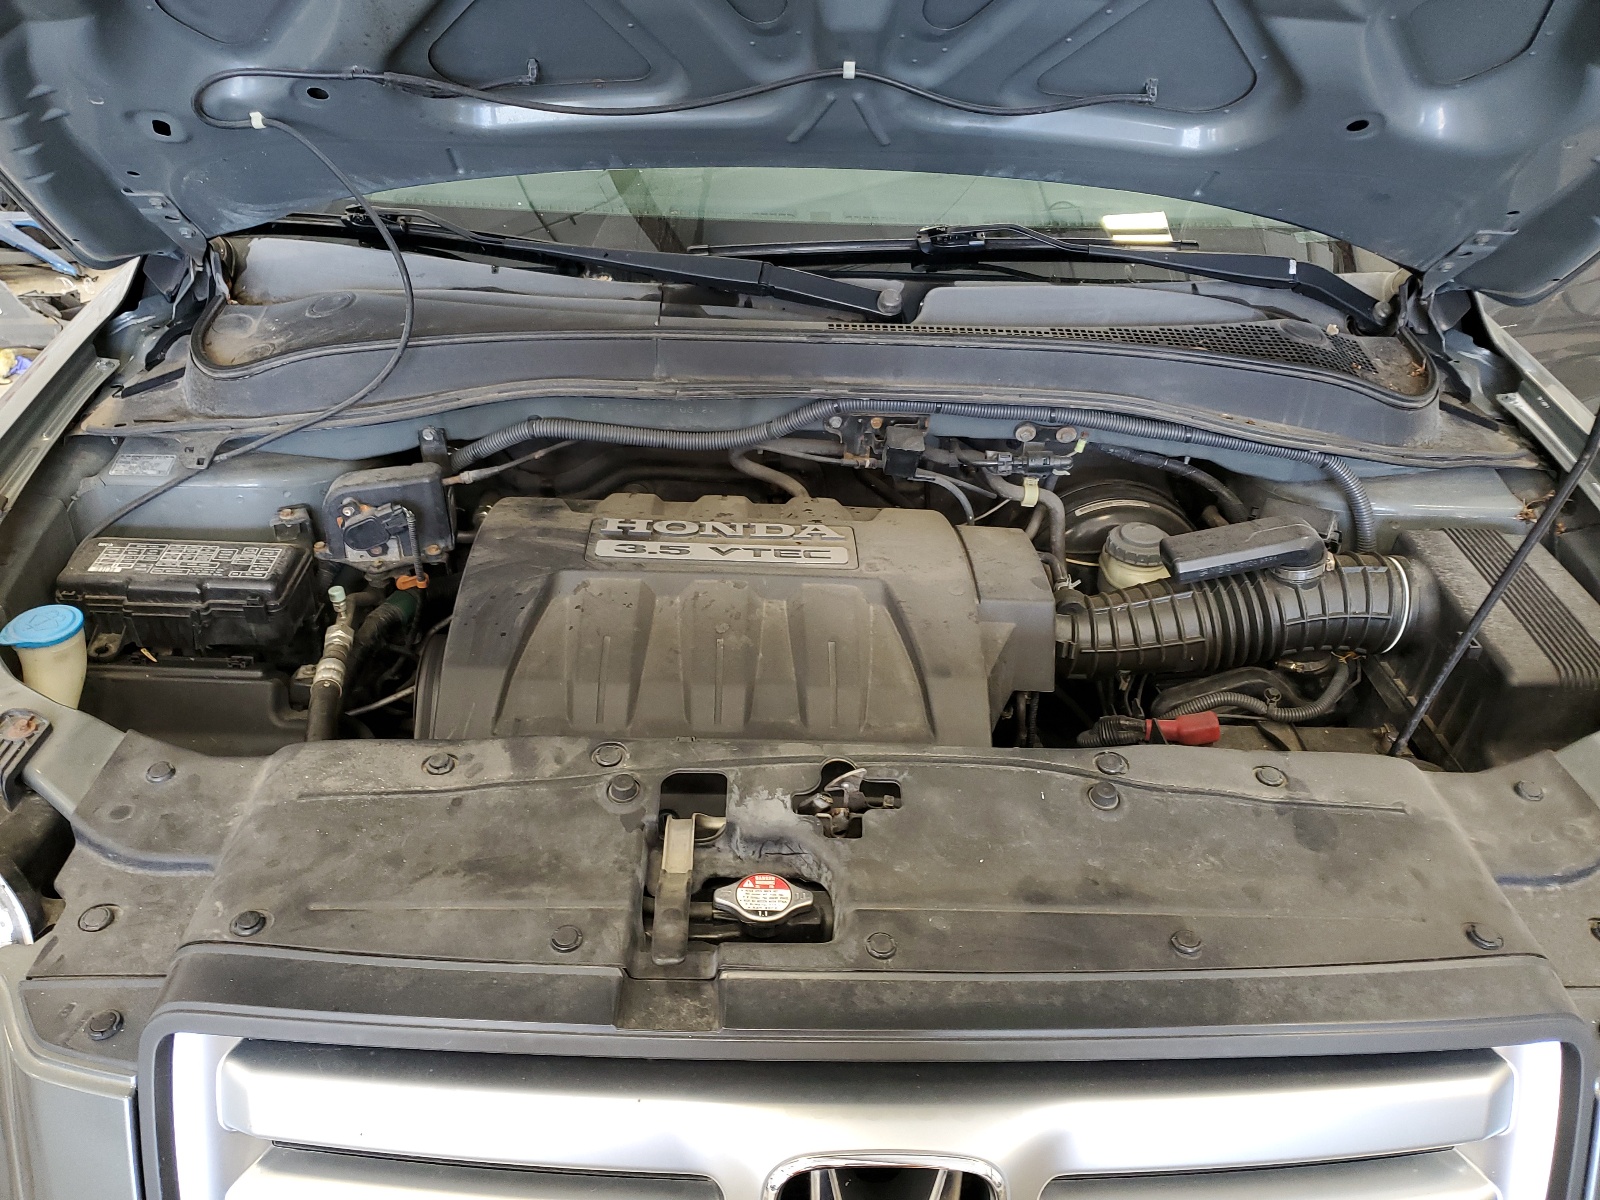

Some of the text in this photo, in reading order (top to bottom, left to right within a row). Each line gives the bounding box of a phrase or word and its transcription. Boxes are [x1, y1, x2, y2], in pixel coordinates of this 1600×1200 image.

[601, 518, 845, 540] HONDA
[614, 543, 832, 559] 3.5 VTEC
